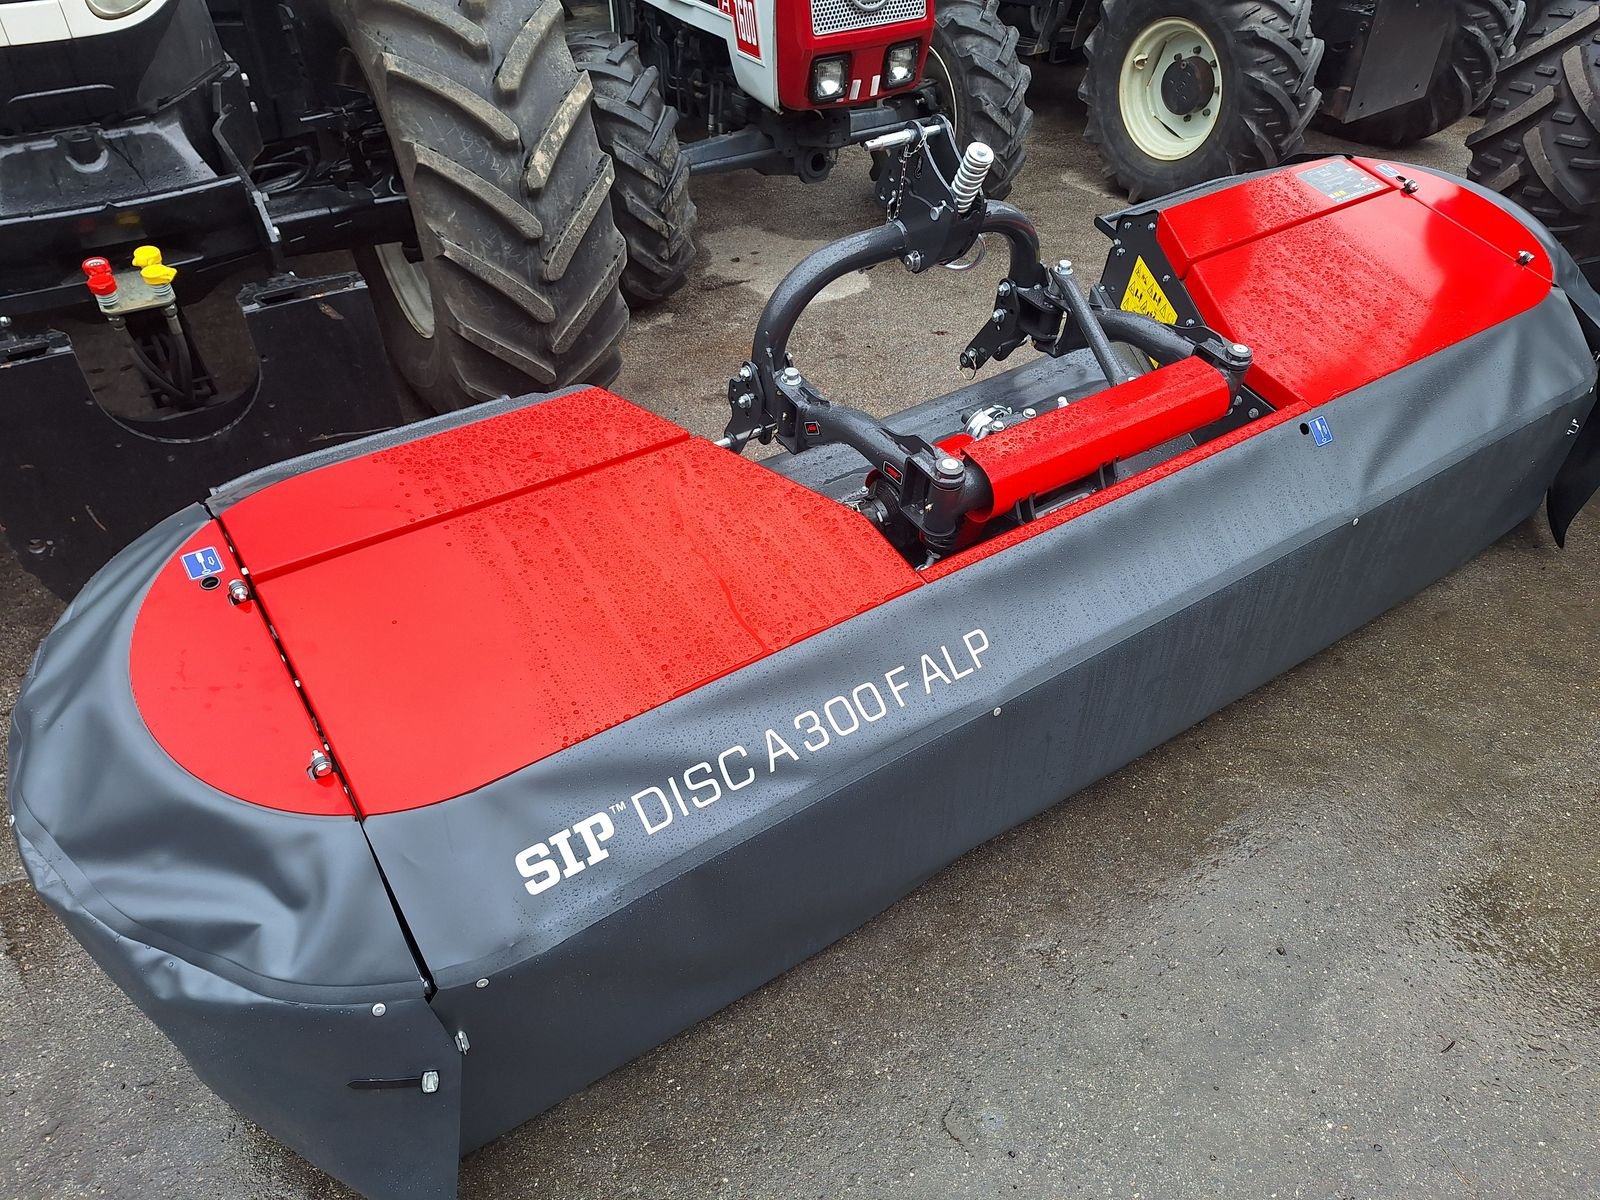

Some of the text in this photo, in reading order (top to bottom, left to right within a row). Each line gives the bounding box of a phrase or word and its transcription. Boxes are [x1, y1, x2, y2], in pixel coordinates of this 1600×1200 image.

[514, 811, 616, 896] SIP
[630, 745, 756, 837] DISC
[919, 628, 990, 695] ALP
